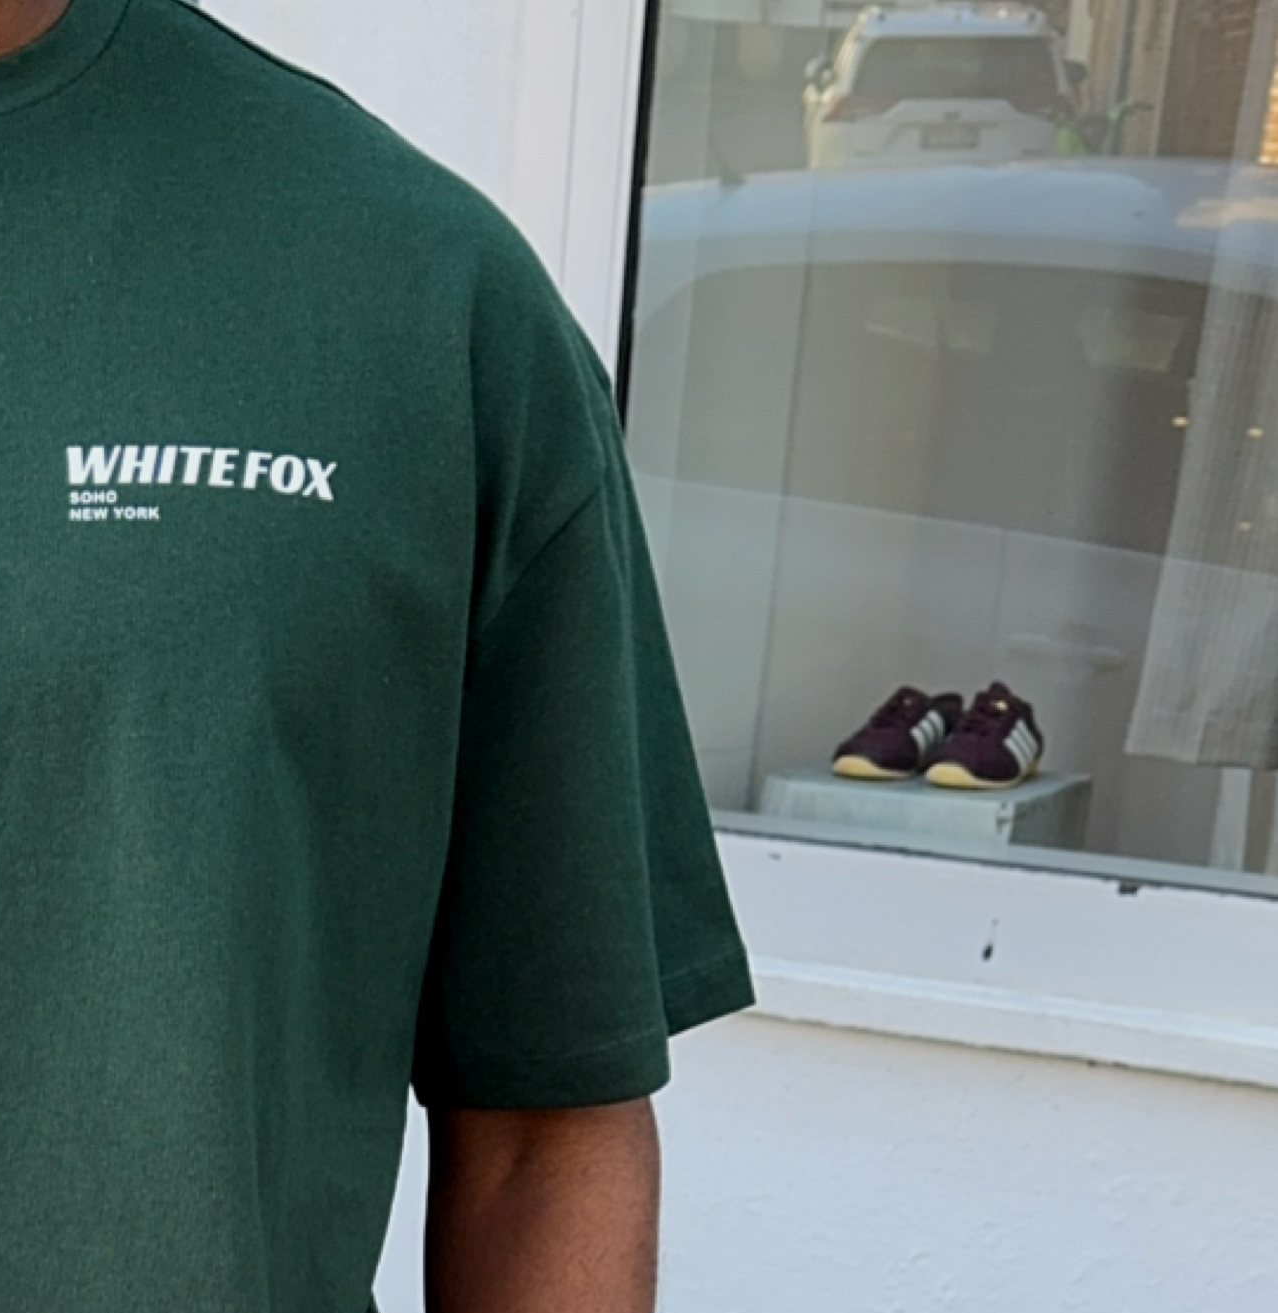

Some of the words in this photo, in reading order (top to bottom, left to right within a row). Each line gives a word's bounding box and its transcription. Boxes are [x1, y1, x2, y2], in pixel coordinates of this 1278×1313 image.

[66, 445, 240, 487] WHITE
[242, 451, 337, 501] FOX
[69, 489, 117, 505] SOHO
[69, 507, 108, 521] NEW
[113, 506, 160, 520] YORK
